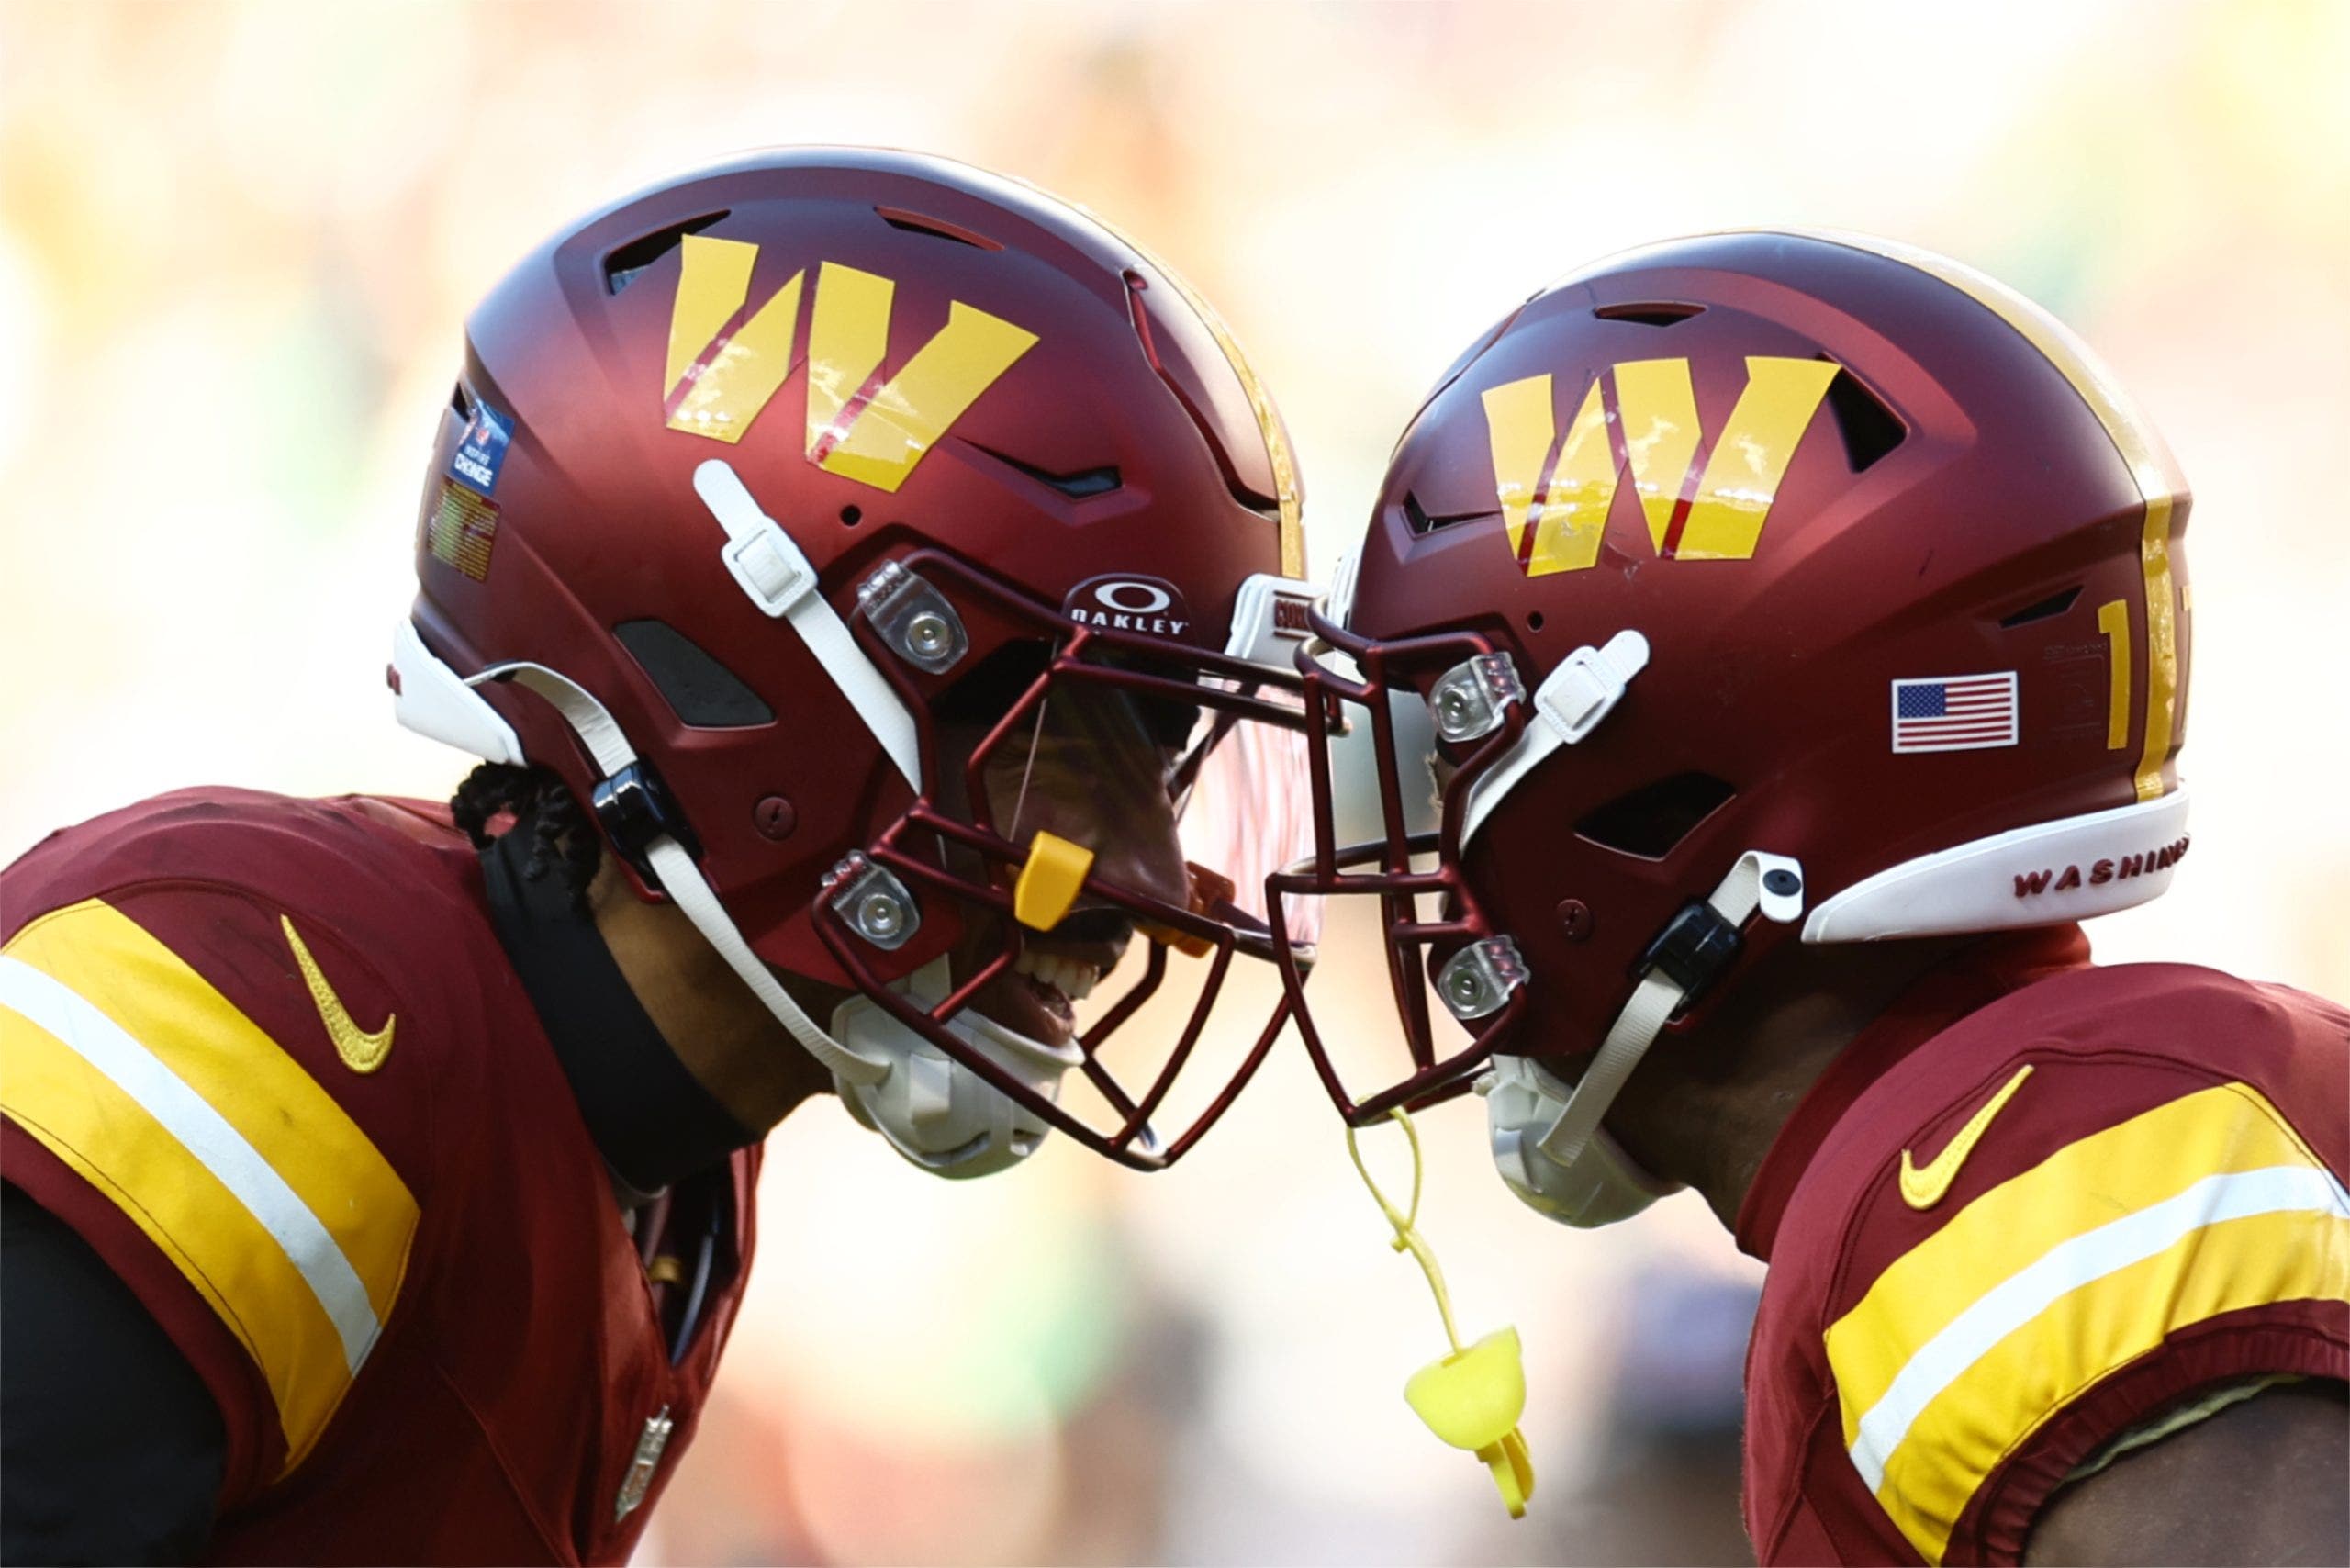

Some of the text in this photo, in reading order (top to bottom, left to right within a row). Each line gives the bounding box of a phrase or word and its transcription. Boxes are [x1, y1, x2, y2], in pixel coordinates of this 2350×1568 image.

[663, 233, 1041, 493] W
[1481, 355, 1843, 577] W
[1070, 608, 1183, 634] OAKLEY
[2098, 599, 2131, 750] 1
